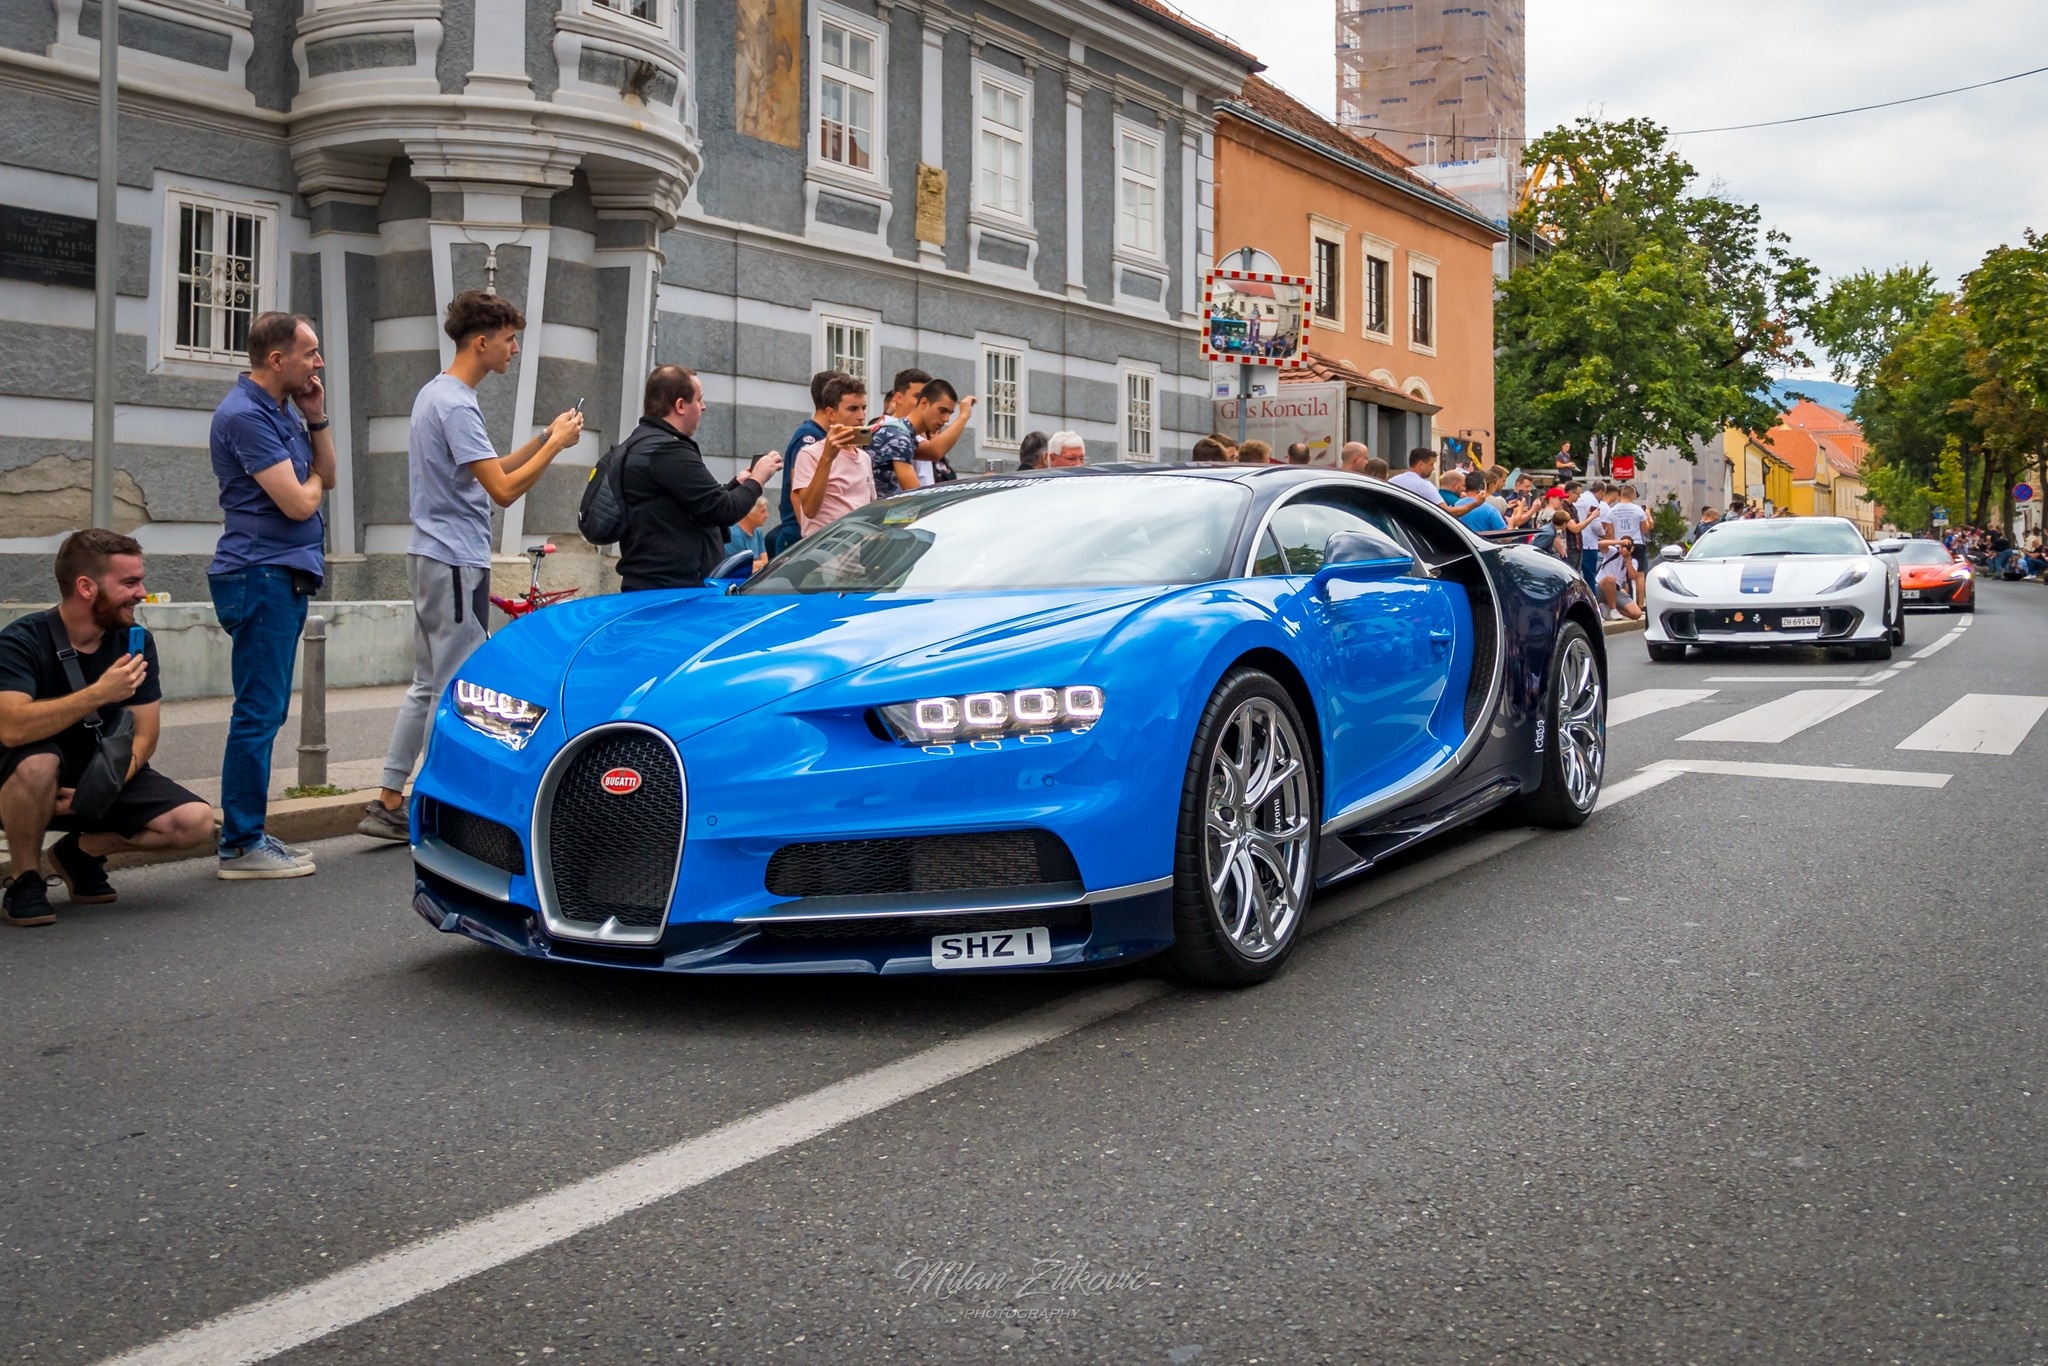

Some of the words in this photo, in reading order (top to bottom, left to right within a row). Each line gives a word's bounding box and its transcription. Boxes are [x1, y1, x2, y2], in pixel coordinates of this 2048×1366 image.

[1261, 397, 1328, 418] Koncila
[605, 776, 637, 787] BUGATTI
[941, 934, 1015, 960] SHZ
